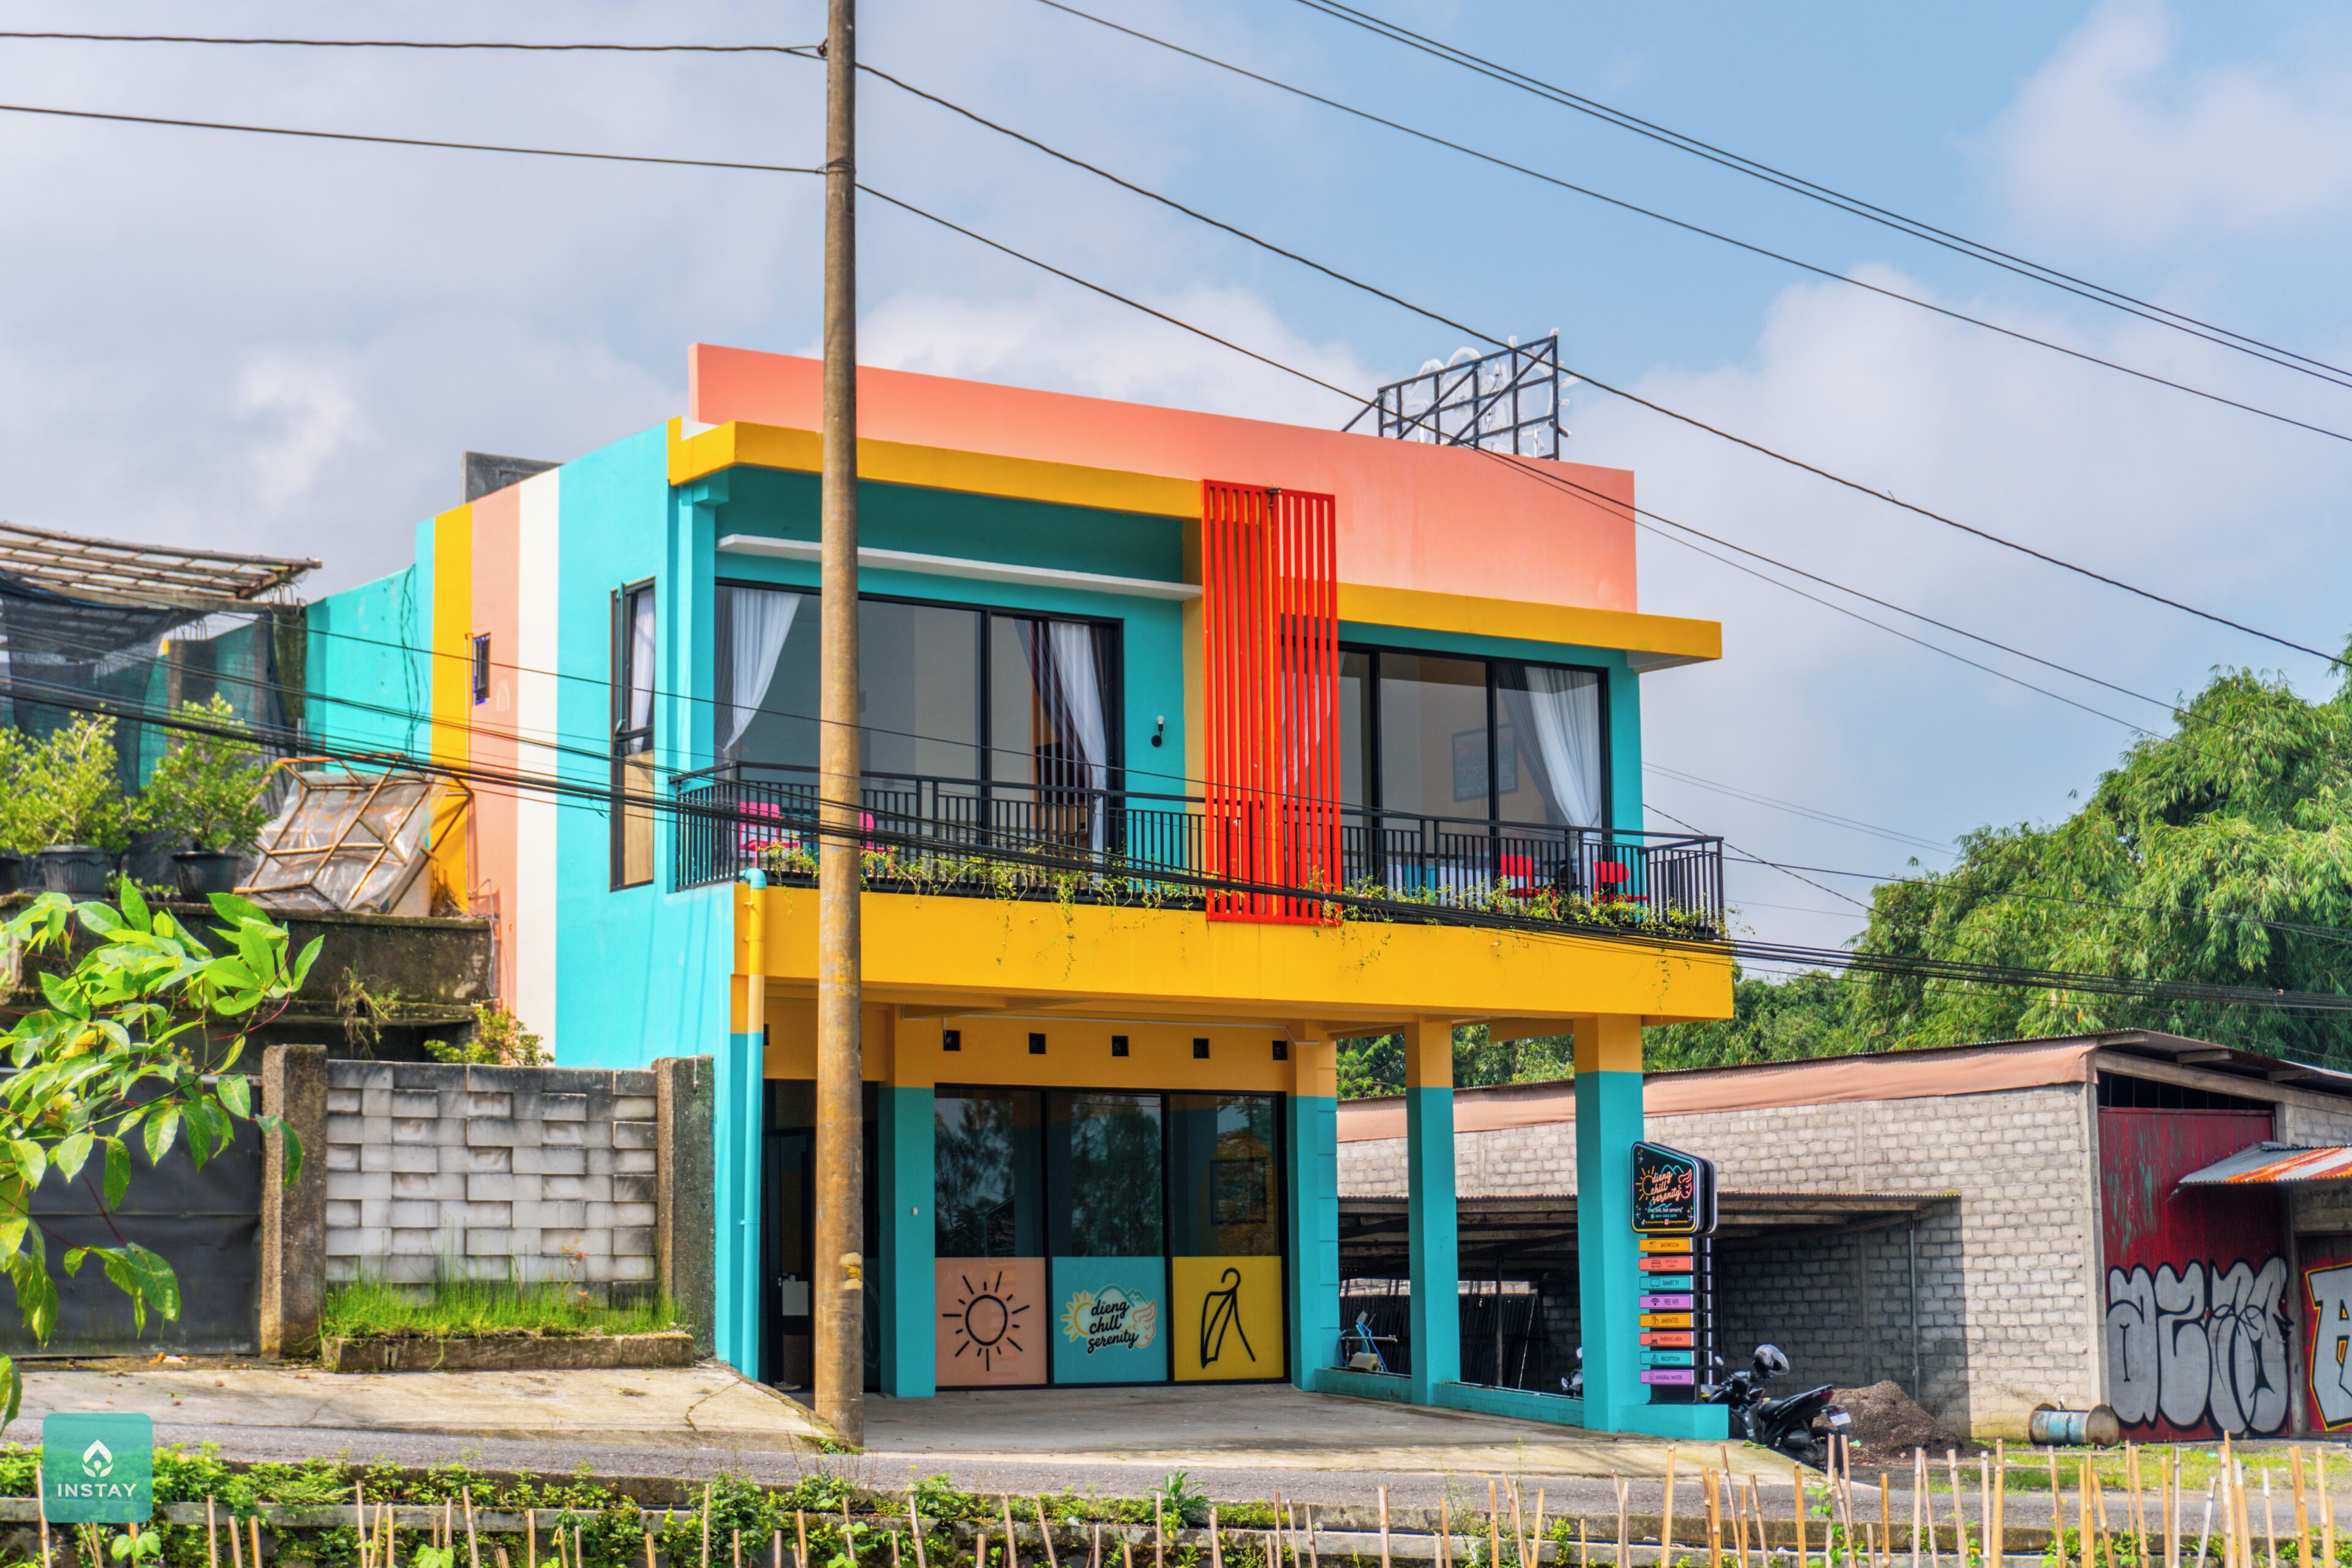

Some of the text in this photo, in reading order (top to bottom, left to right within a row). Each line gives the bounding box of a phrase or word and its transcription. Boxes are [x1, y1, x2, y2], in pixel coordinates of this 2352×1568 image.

[1652, 1171, 1673, 1184] dieng
[1651, 1180, 1668, 1195] chill
[1652, 1187, 1681, 1205] serenity
[1091, 1299, 1130, 1319] dieng
[1089, 1314, 1122, 1334] chill
[1087, 1329, 1139, 1354] serenity
